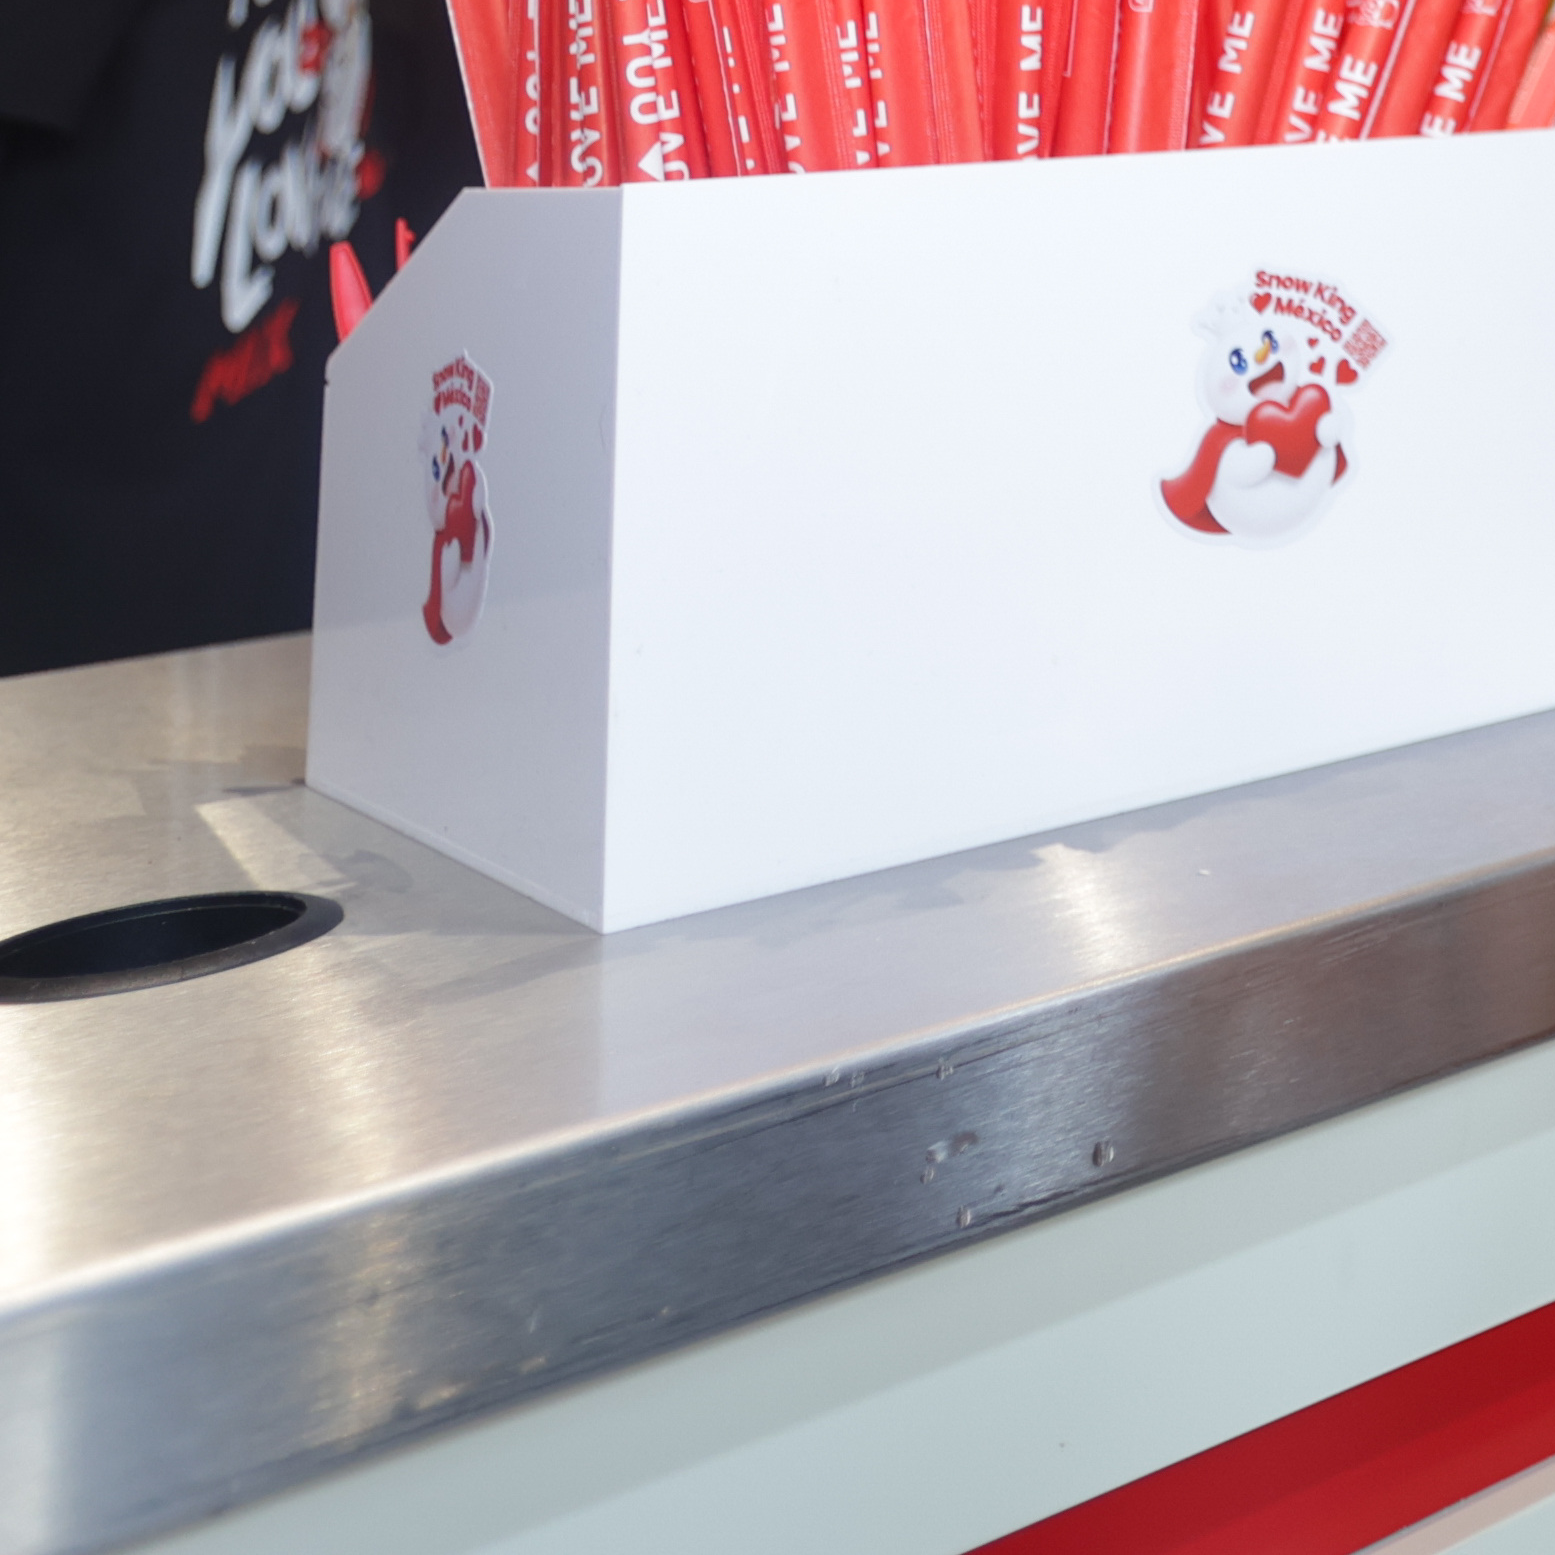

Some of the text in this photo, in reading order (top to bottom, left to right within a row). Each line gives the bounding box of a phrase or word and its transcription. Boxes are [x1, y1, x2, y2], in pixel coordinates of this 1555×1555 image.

[1019, 4, 1043, 72] ME
[1217, 10, 1256, 75] ME
[1303, 7, 1343, 73] ME
[1327, 54, 1379, 122] ME
[1433, 40, 1483, 103] ME
[1254, 270, 1357, 326] Snow King
[1274, 294, 1342, 342] México
